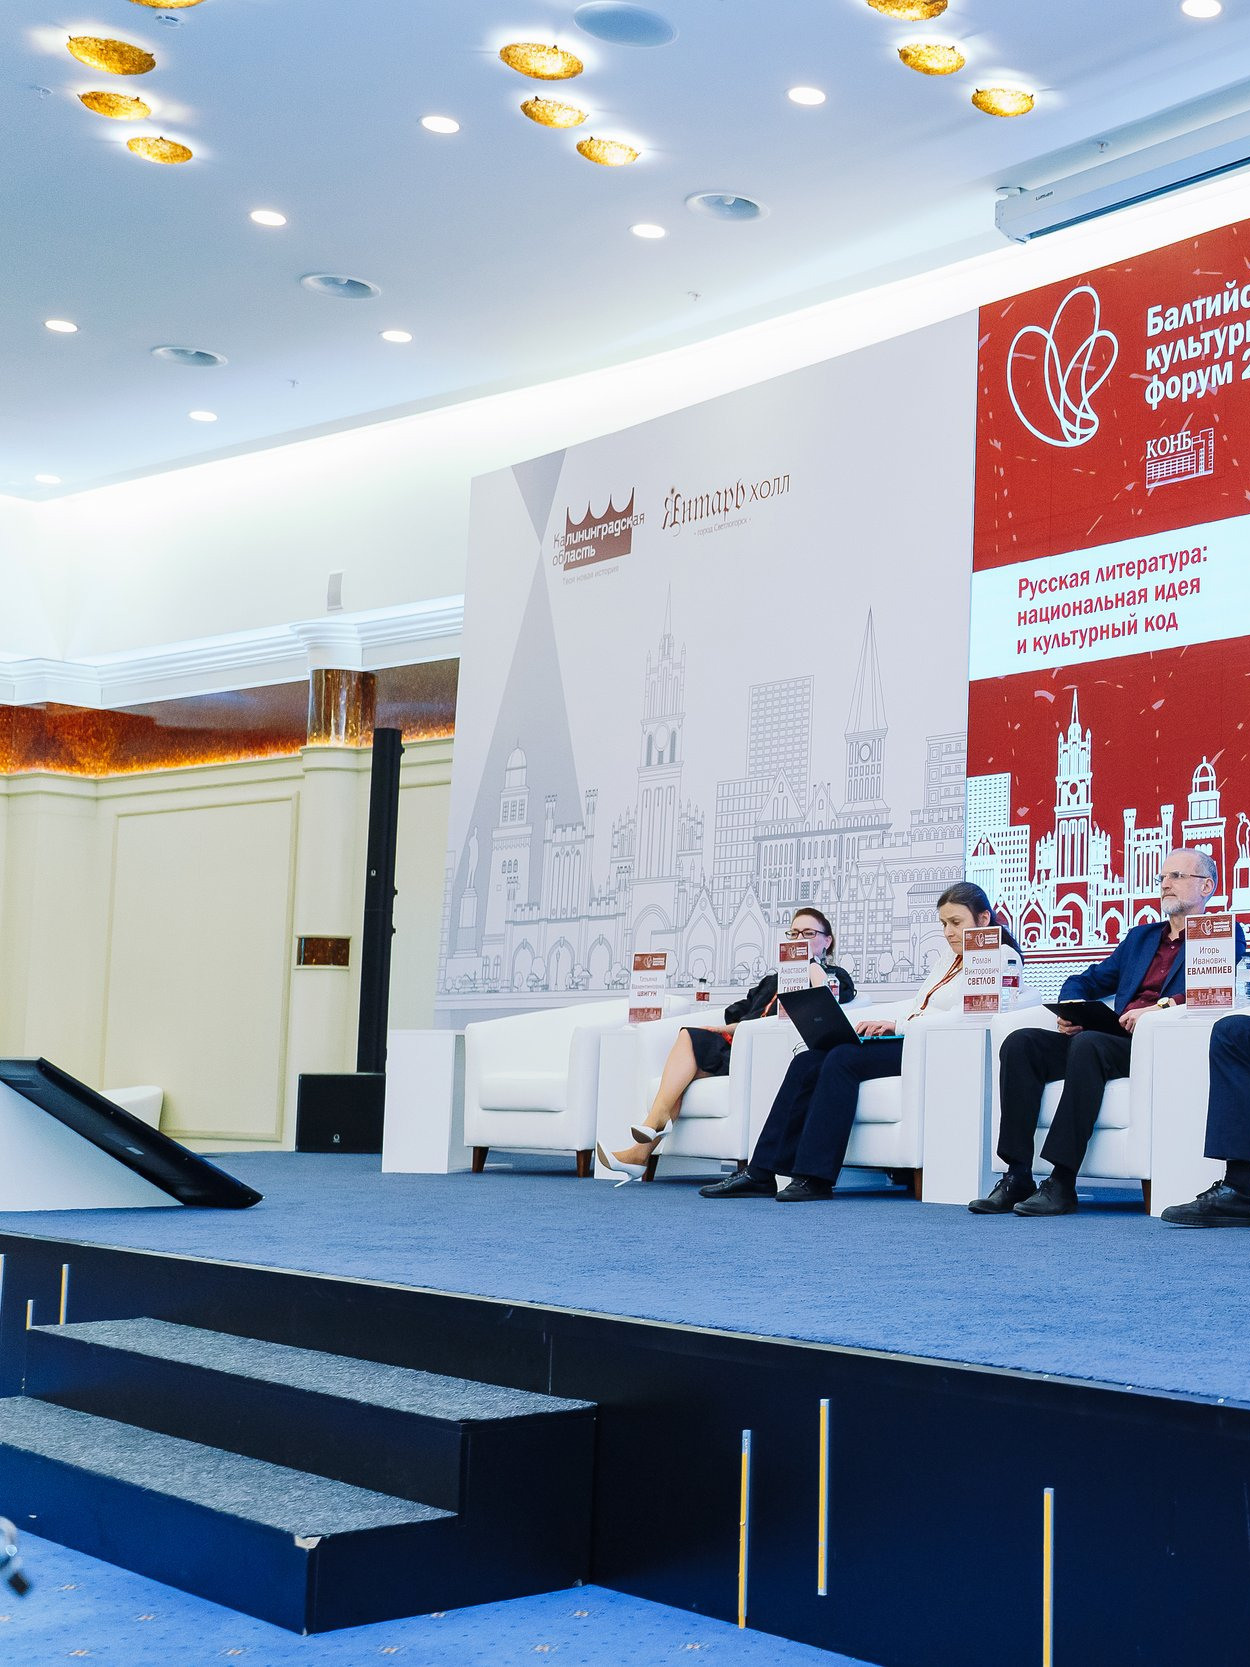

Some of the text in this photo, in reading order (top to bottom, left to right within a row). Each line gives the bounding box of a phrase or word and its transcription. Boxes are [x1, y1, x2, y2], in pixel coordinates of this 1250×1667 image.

[1144, 361, 1233, 411] форум
[1145, 431, 1192, 460] КОНБ
[553, 513, 645, 549] Калининградская
[552, 545, 597, 567] область
[1017, 545, 1208, 600] Русская литература:
[1017, 577, 1201, 627] национальная идея
[1016, 611, 1179, 656] и культурный код
[972, 957, 992, 965] Роман
[1192, 957, 1227, 965] Иванович
[1199, 946, 1220, 956] Игорь
[964, 967, 1000, 977] Викторович
[967, 976, 996, 986] СВЕТЛОВ
[1187, 965, 1233, 976] ЕВЛАМПИЕВ
